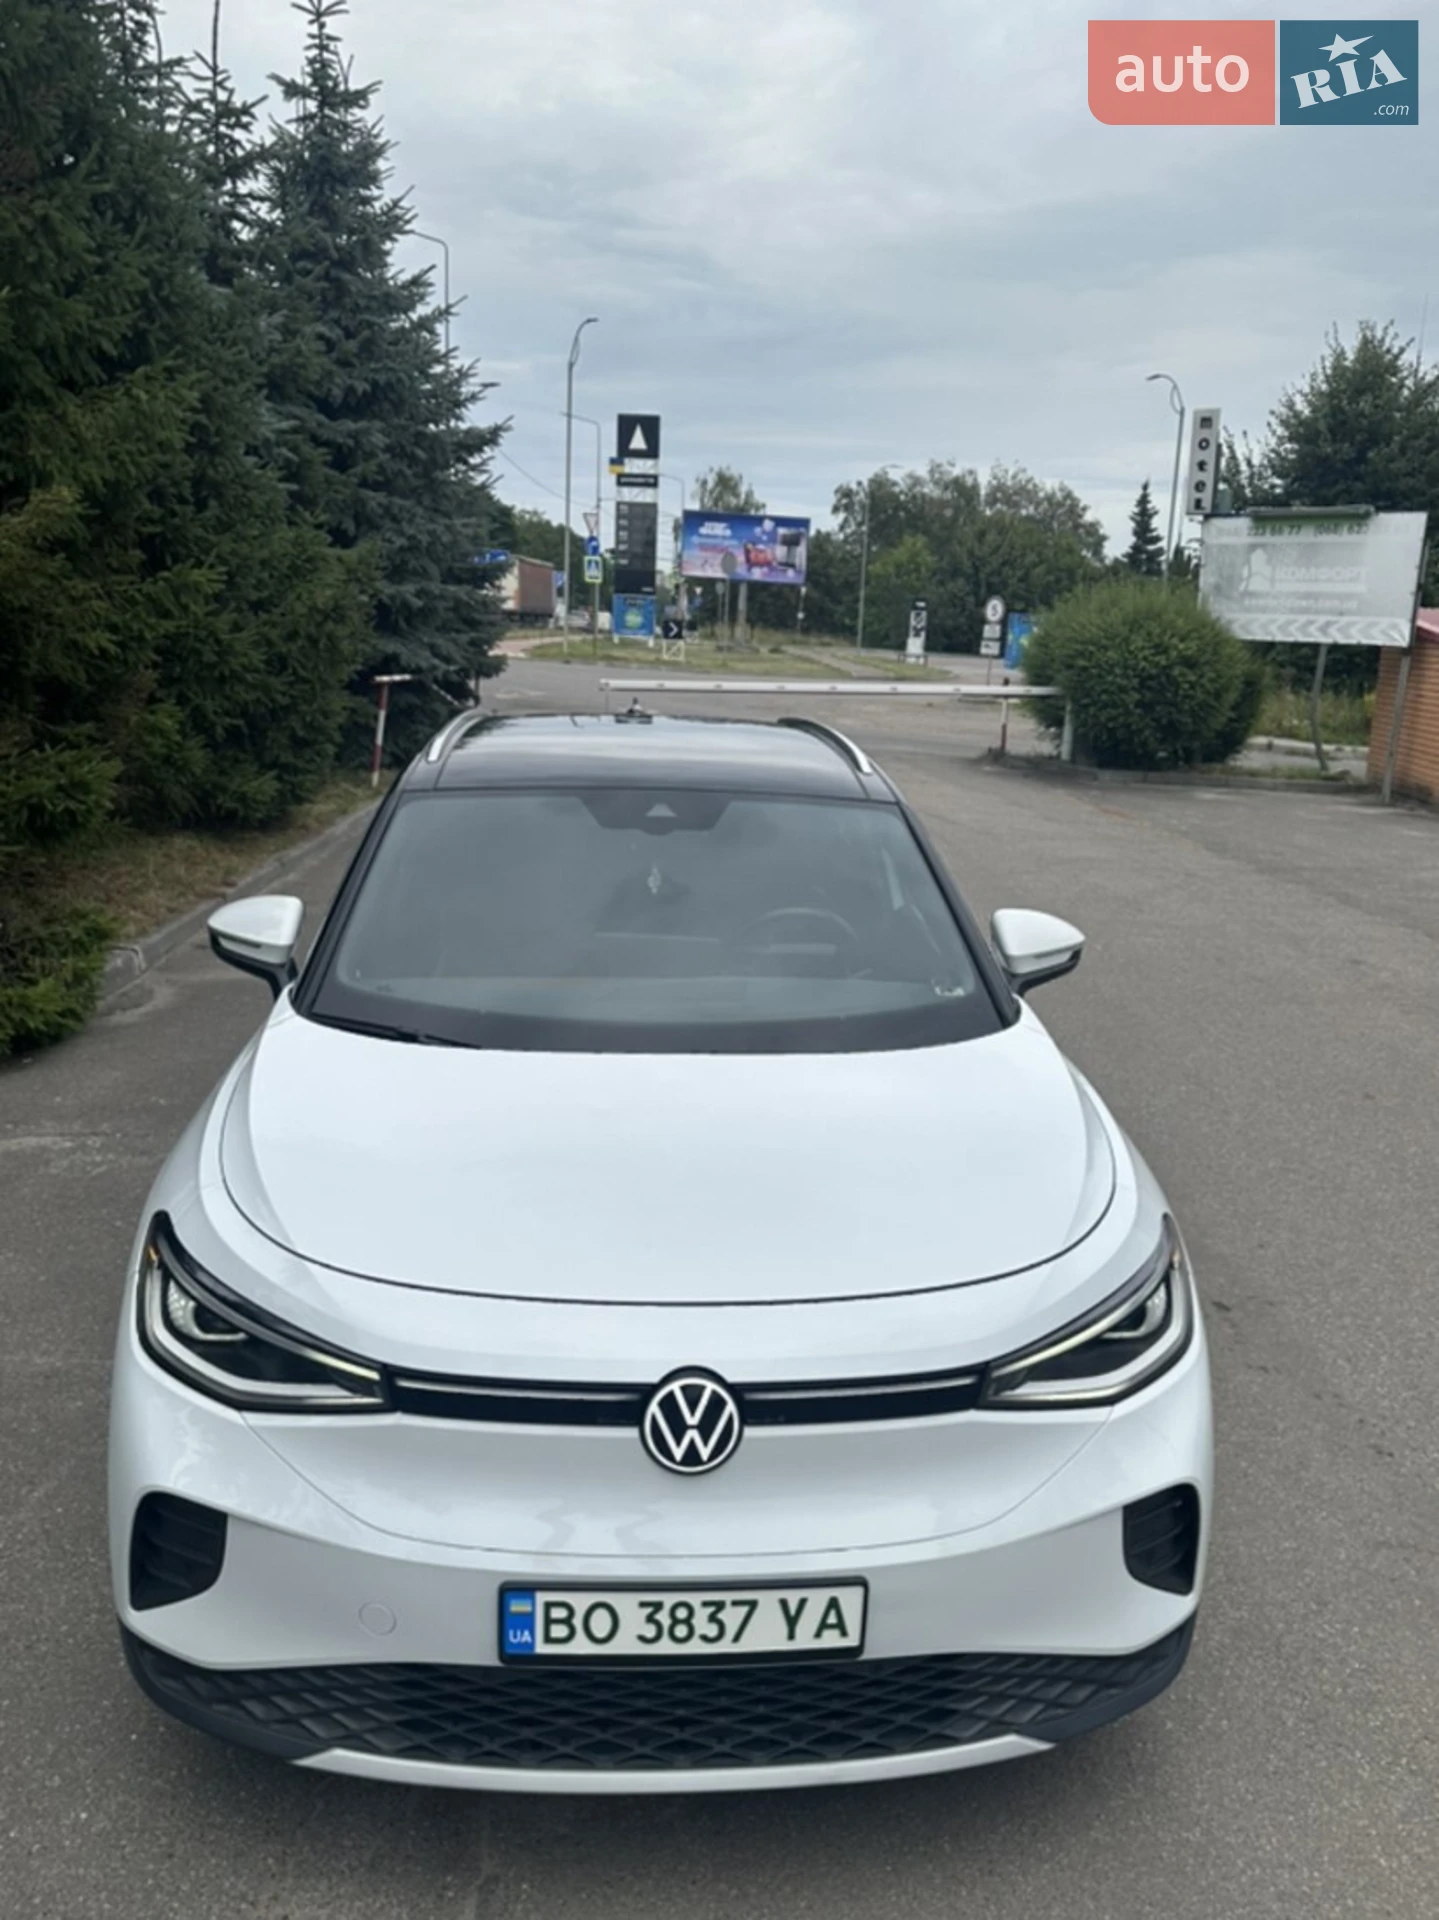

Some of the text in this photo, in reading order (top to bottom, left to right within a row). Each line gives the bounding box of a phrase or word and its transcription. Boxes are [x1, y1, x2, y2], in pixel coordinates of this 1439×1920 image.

[509, 1629, 533, 1645] UA
[636, 1598, 759, 1646] 3837
[778, 1596, 850, 1642] YA
